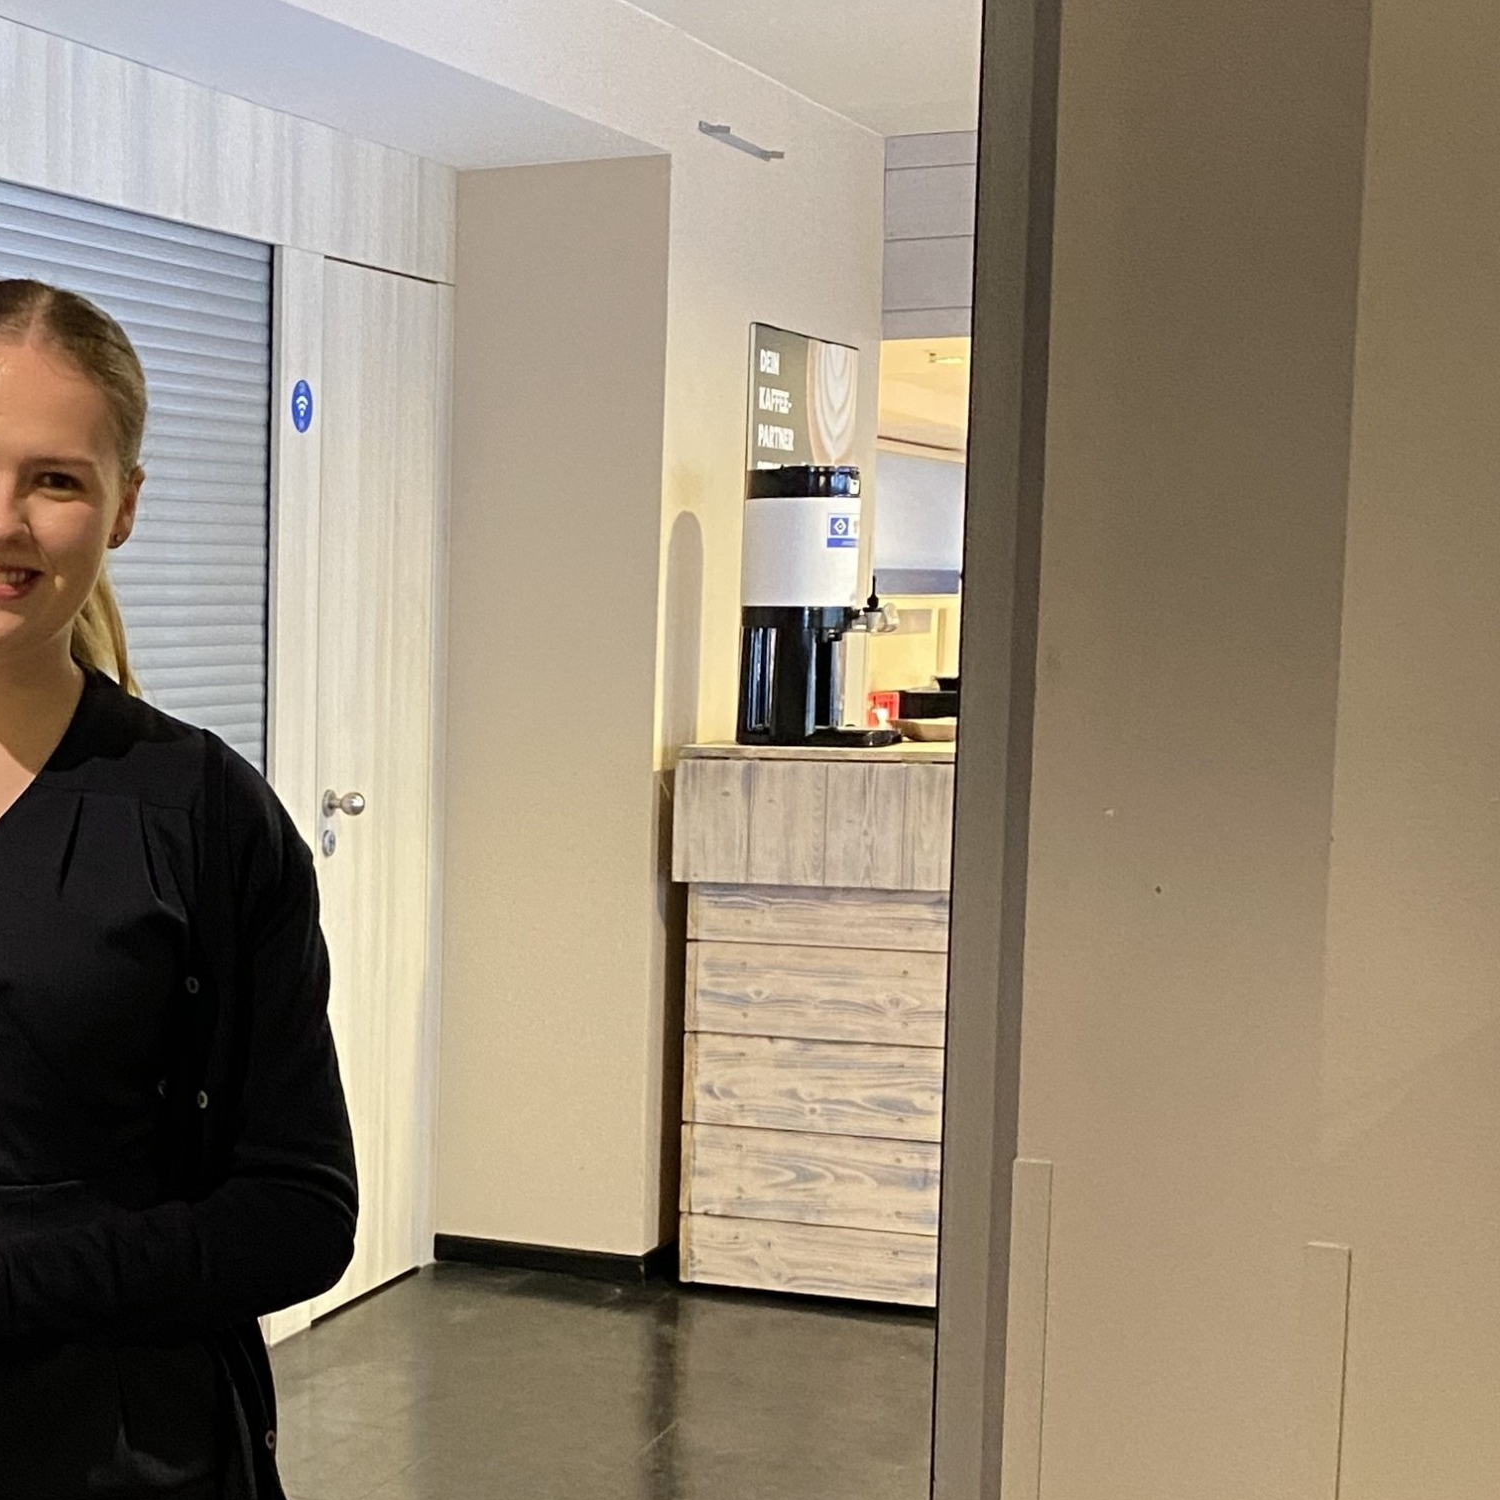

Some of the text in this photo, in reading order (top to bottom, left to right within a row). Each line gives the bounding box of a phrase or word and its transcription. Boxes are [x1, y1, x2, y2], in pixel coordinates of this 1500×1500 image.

[760, 348, 780, 375] DEIN
[758, 386, 793, 414] KAFFEE-
[757, 423, 794, 451] PARTNER
